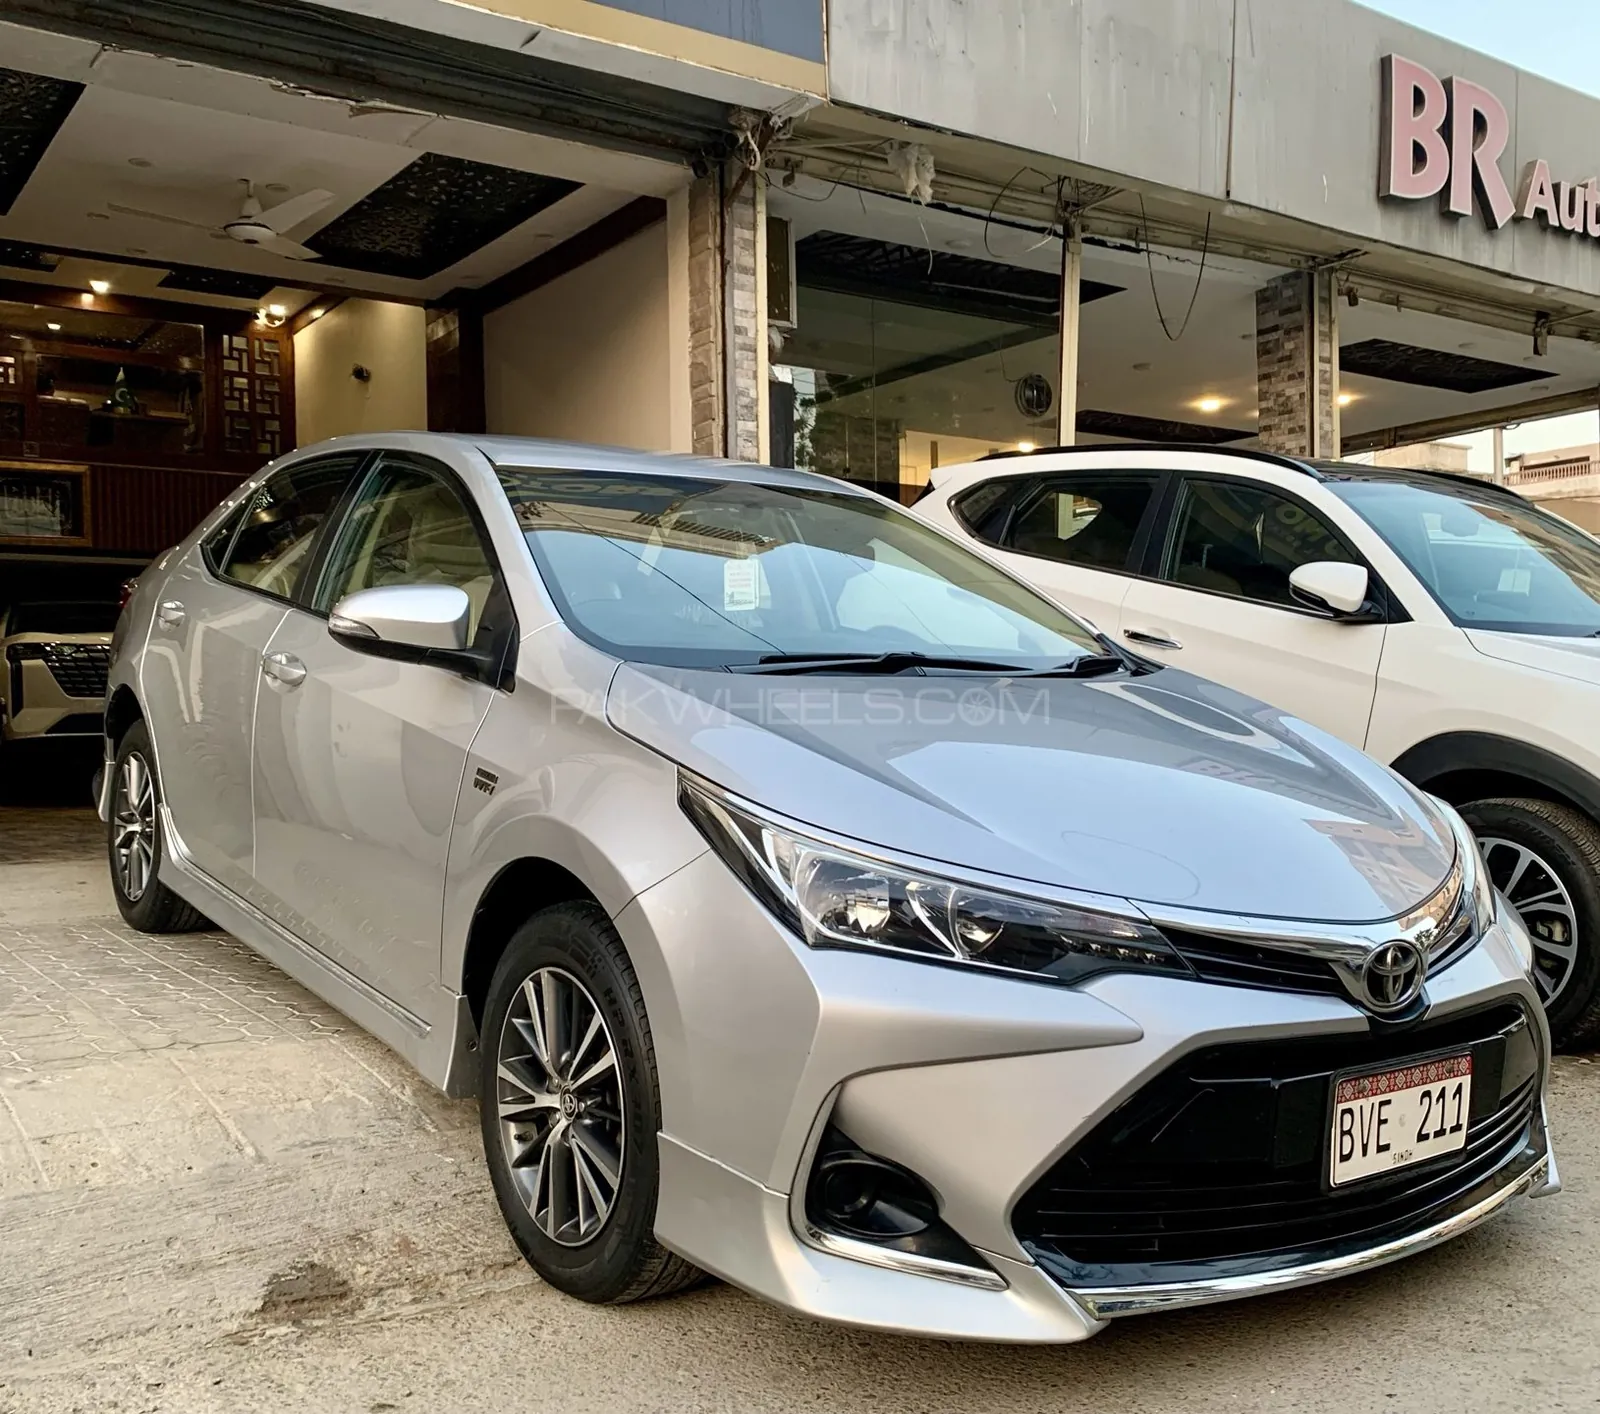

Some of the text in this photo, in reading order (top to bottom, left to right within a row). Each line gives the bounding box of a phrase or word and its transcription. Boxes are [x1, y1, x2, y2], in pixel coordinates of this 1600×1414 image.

[1383, 53, 1516, 229] BR
[1339, 1082, 1463, 1164] BVE 211
